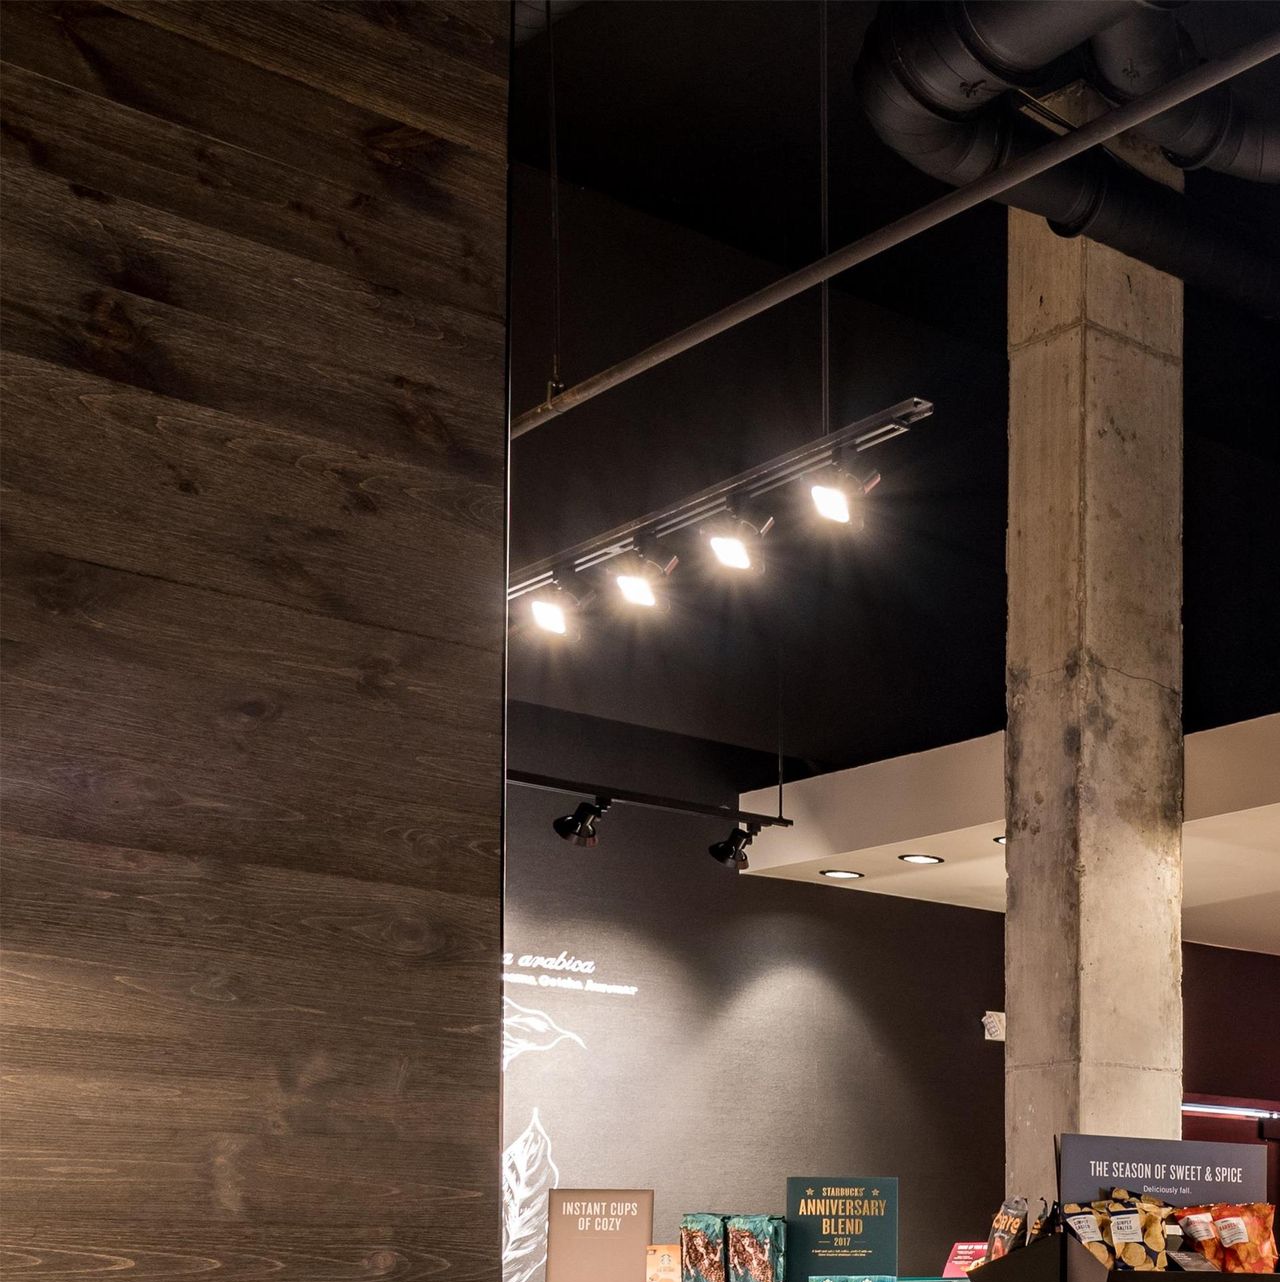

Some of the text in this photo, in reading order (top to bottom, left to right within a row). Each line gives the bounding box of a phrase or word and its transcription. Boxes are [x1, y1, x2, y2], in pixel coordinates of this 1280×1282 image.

[518, 951, 596, 973] arabica
[1090, 1161, 1243, 1183] THE SEASON OF SWEET & SPICE
[822, 1187, 865, 1197] STARBUCKS
[1143, 1185, 1192, 1195] Deliciously fall.
[562, 1202, 638, 1216] INSTANT CUPS
[798, 1198, 887, 1217] ANNIVERSARY
[578, 1217, 622, 1231] OF COZY
[822, 1218, 863, 1235] BLEND
[833, 1237, 851, 1246] 2017
